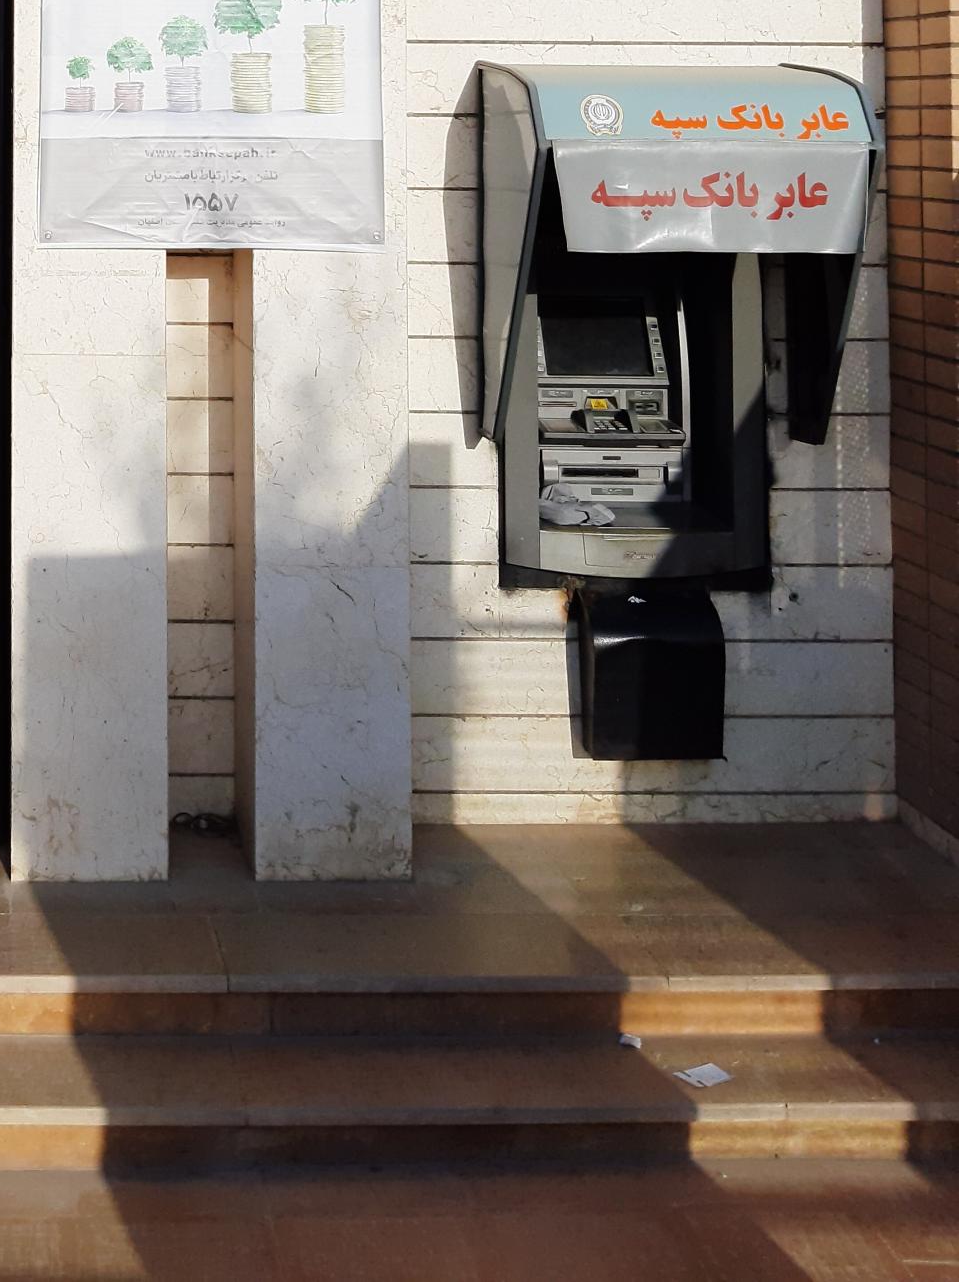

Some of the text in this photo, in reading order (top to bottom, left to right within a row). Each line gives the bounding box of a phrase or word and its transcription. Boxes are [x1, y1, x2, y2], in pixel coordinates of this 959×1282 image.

[650, 104, 849, 139] عابر بانک سپه
[591, 171, 829, 222] عابر بانک سپه
